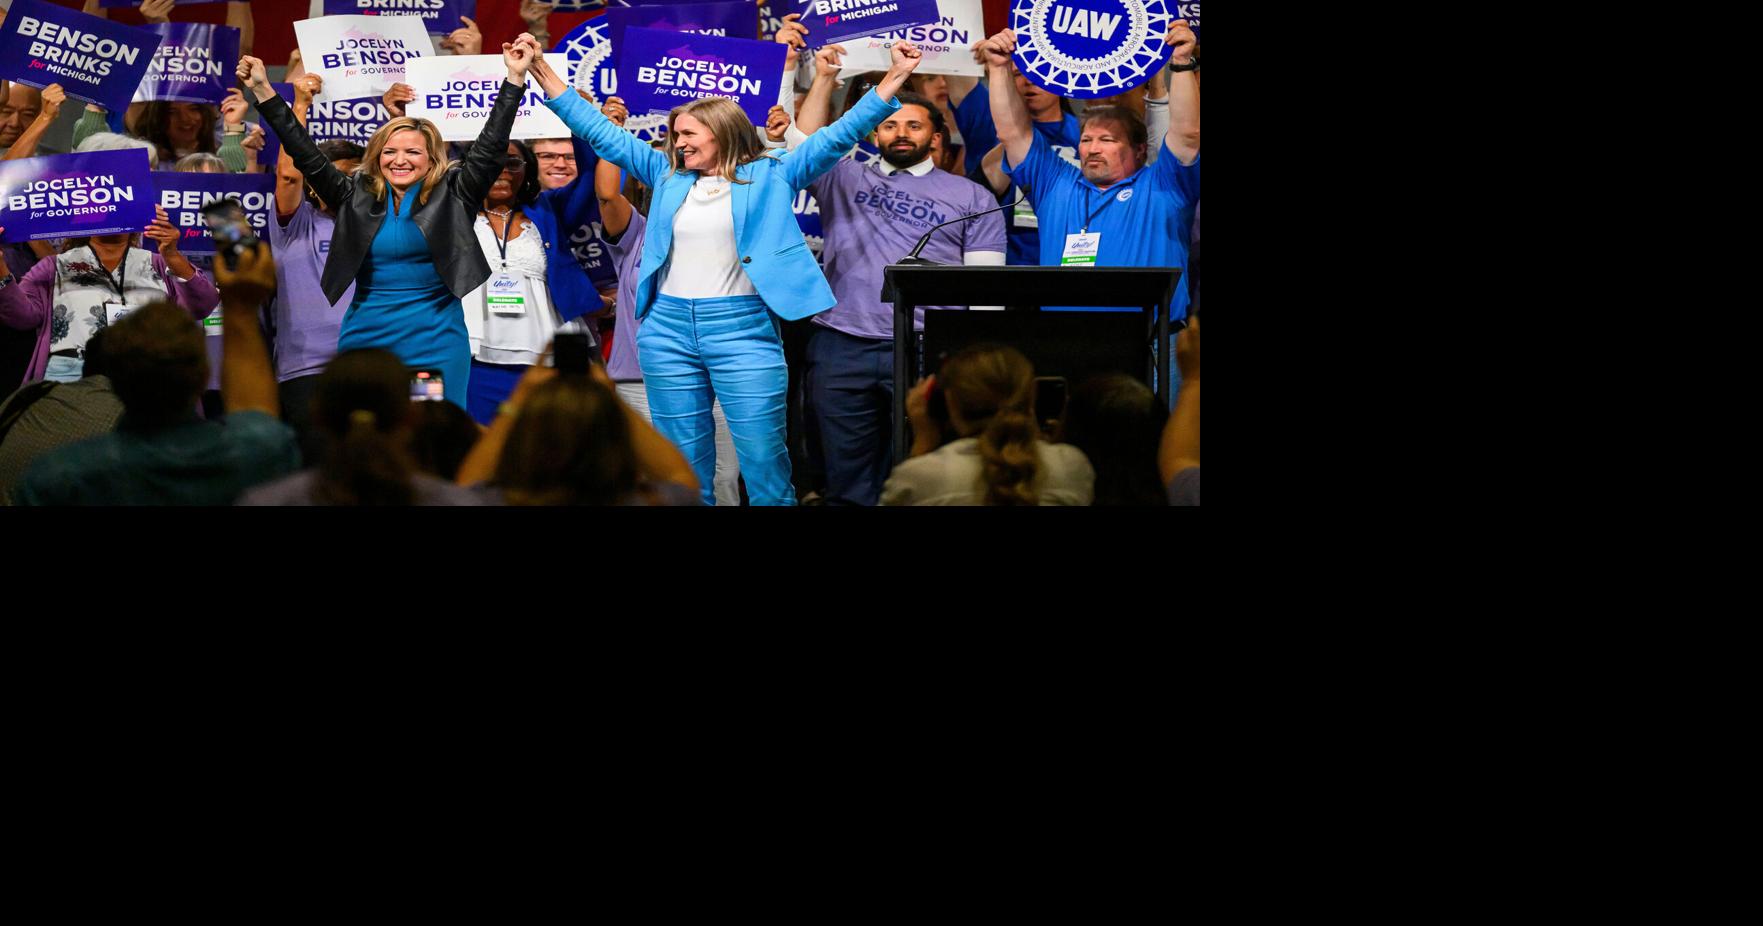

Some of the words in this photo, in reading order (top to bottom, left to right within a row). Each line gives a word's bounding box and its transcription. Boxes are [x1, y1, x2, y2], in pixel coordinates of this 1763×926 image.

[825, 16, 840, 27] for
[841, 4, 898, 21] MICHIGAN
[1052, 5, 1122, 41] UAW
[17, 16, 140, 65] BENSON
[335, 39, 405, 51] JOCELYN
[28, 41, 113, 76] BRINKS
[656, 57, 747, 76] JOCELYN
[28, 59, 47, 70] for
[46, 63, 101, 85] MICHIGAN
[637, 67, 761, 96] BENSON
[654, 86, 669, 95] for
[445, 111, 458, 119] for
[24, 175, 115, 193] JOCELYN
[8, 186, 134, 211] BENSON
[854, 191, 946, 225] BENSON
[30, 212, 44, 220] for
[46, 205, 117, 217] GOVERNOR
[185, 229, 201, 238] for
